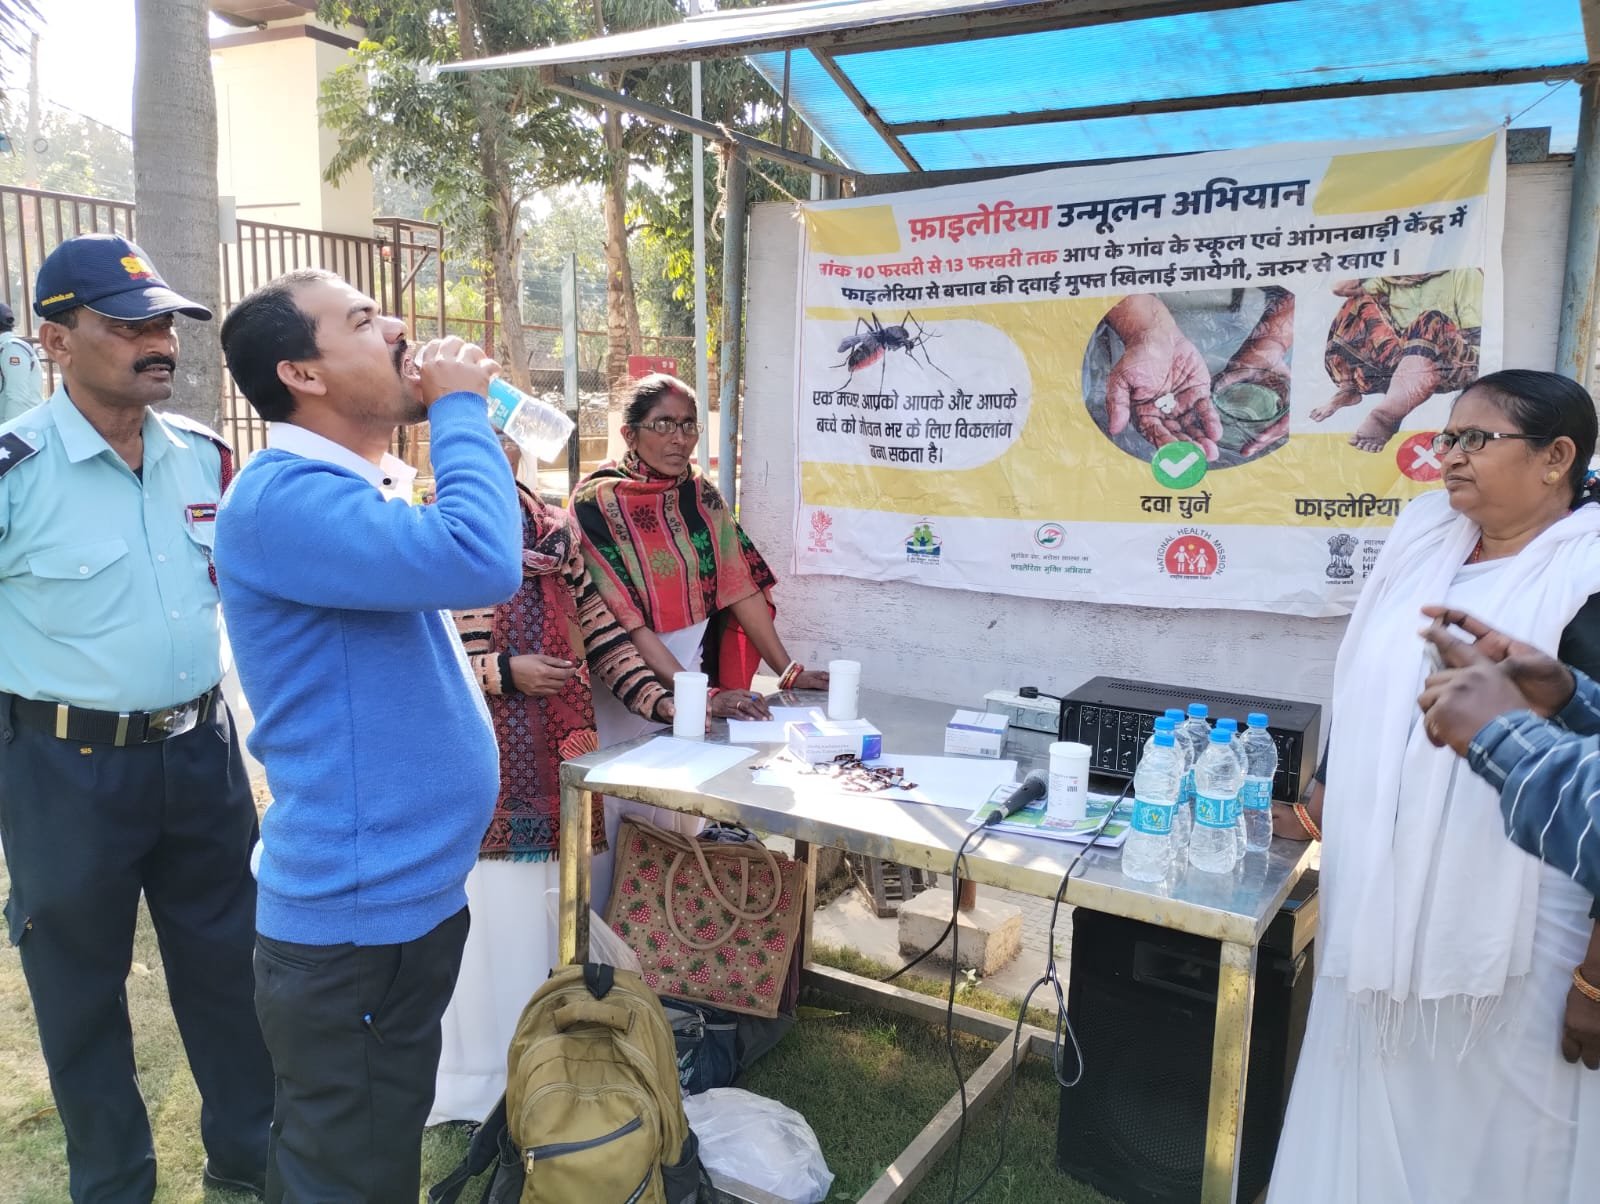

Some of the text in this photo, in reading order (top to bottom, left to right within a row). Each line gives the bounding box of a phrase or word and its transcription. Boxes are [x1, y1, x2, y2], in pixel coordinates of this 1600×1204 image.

[908, 177, 1310, 243] फ़ाइलेरिया उन्मूलन अभियान
[856, 266, 875, 279] 10
[877, 256, 924, 277] फरवरी
[927, 255, 942, 274] से
[945, 258, 963, 273] 13
[967, 248, 1023, 270] फरवरी
[1026, 250, 1060, 266] तक
[1063, 246, 1101, 263] आप
[1104, 240, 1125, 259] के
[1128, 237, 1165, 257] गांव
[1168, 234, 1190, 254] के
[1193, 234, 1247, 258] स्कूल
[1250, 227, 1283, 249] एवं
[1287, 216, 1401, 247] आंगनबाड़ी
[1404, 211, 1446, 235] केंद्र
[1449, 205, 1468, 228] में
[841, 283, 923, 305] फाइलेरिया
[926, 281, 940, 299] से
[942, 281, 987, 298] बचाव
[990, 275, 1014, 295] की
[1017, 271, 1062, 295] दवाई
[1065, 273, 1107, 296] मुफ्त
[1110, 263, 1177, 287] खिलाई
[1180, 257, 1253, 282] जायेगी,
[1312, 252, 1333, 272] से
[813, 391, 835, 406] एक
[903, 391, 944, 411] आपके
[948, 389, 974, 411] और
[976, 388, 1018, 410] आपके
[816, 413, 838, 433] बच्चे
[841, 414, 856, 434] को
[885, 422, 903, 438] भर
[906, 418, 920, 438] के
[925, 418, 951, 439] लिए
[955, 417, 1013, 439] विकलांग
[869, 444, 888, 461] बना
[888, 446, 924, 463] सकता
[1140, 491, 1211, 519] दवा चुनें
[1295, 493, 1402, 519] फाइलेरिया
[1157, 527, 1226, 576] NATIONAL HEALTH MISSION
